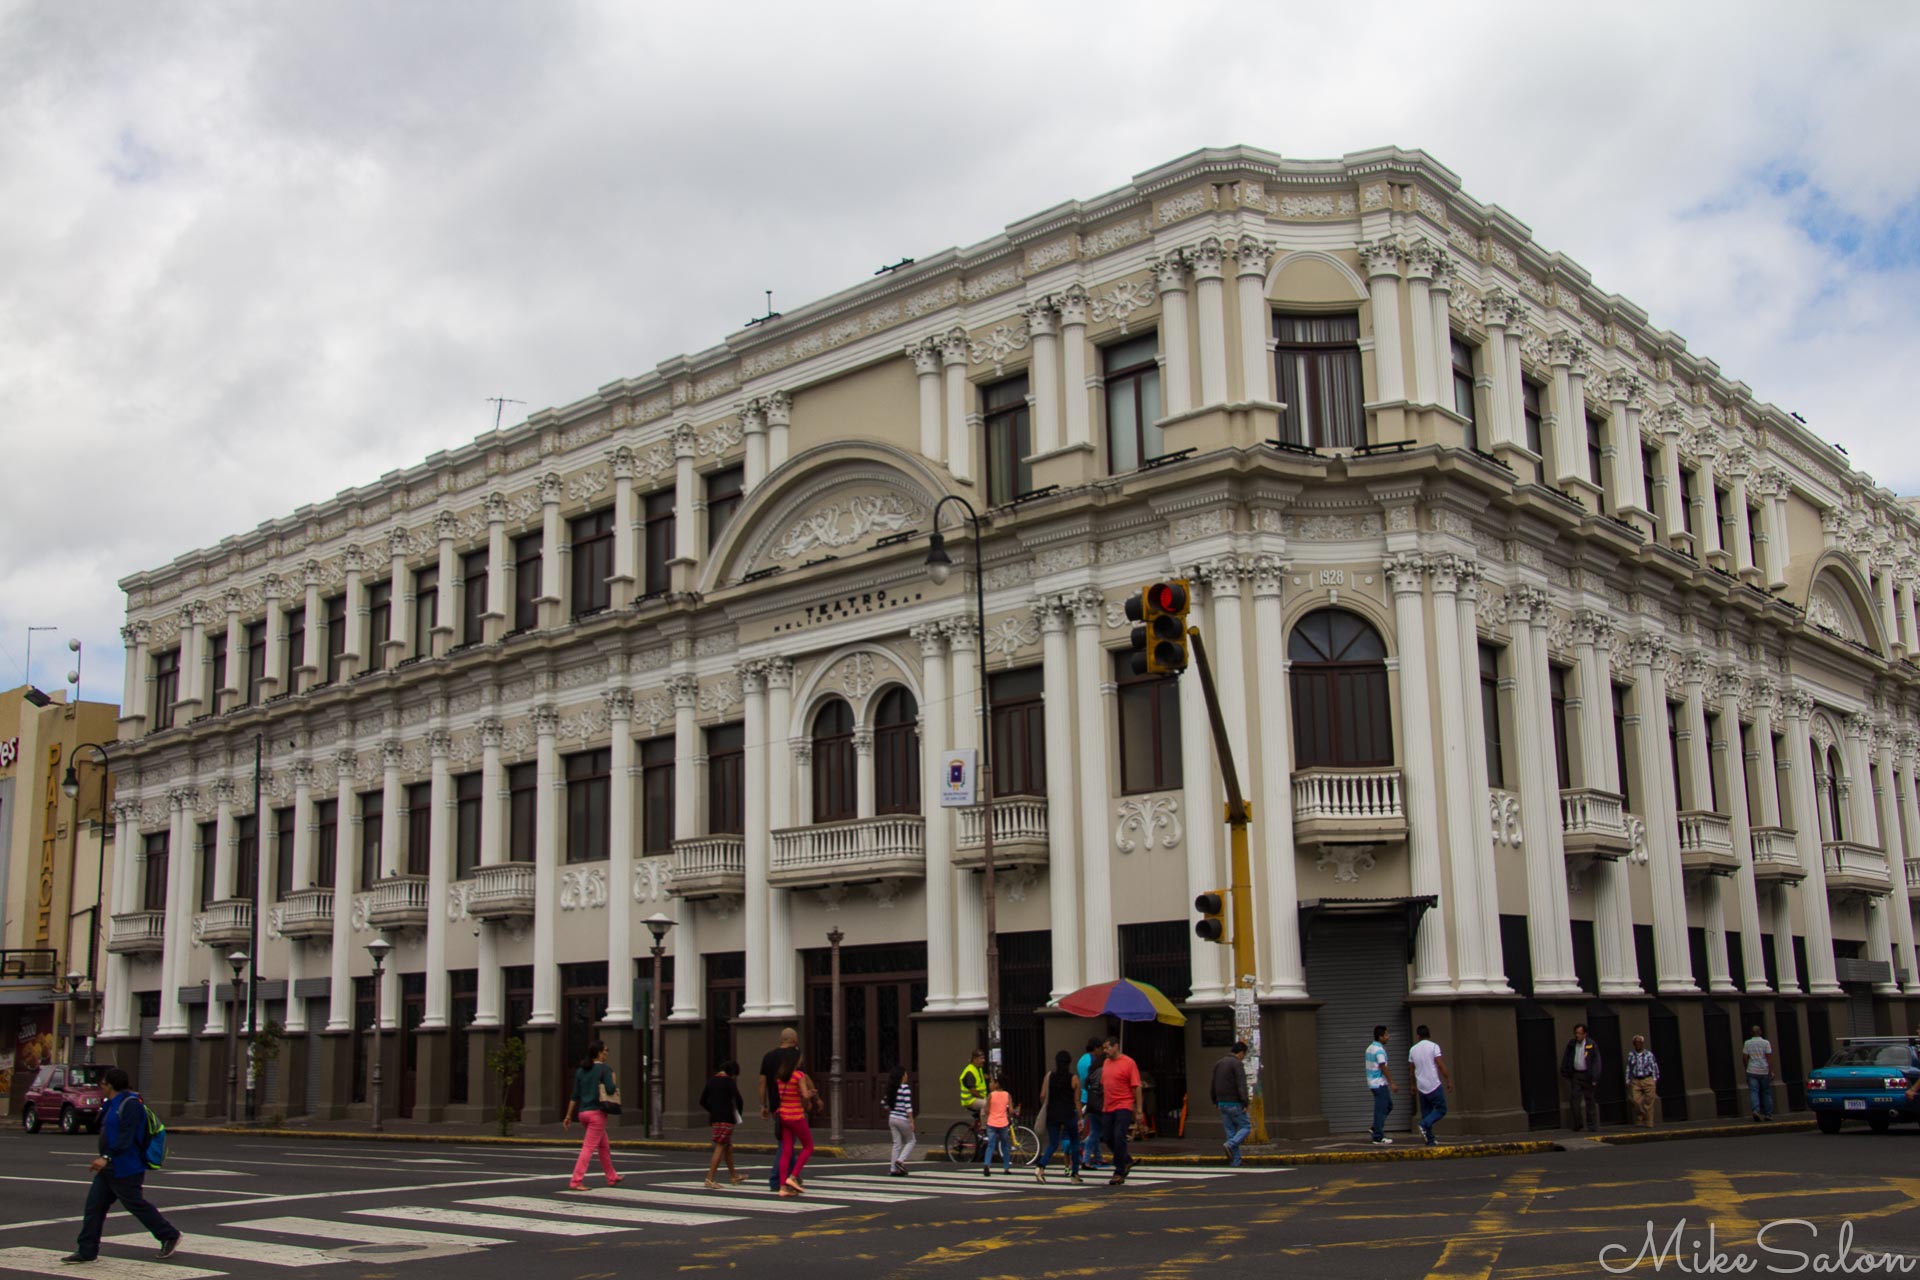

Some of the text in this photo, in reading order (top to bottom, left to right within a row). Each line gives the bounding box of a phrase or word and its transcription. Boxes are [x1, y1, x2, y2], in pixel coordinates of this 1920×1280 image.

[1319, 569, 1344, 585] 1928
[805, 590, 886, 618] TEATRO
[36, 743, 62, 942] PALACE
